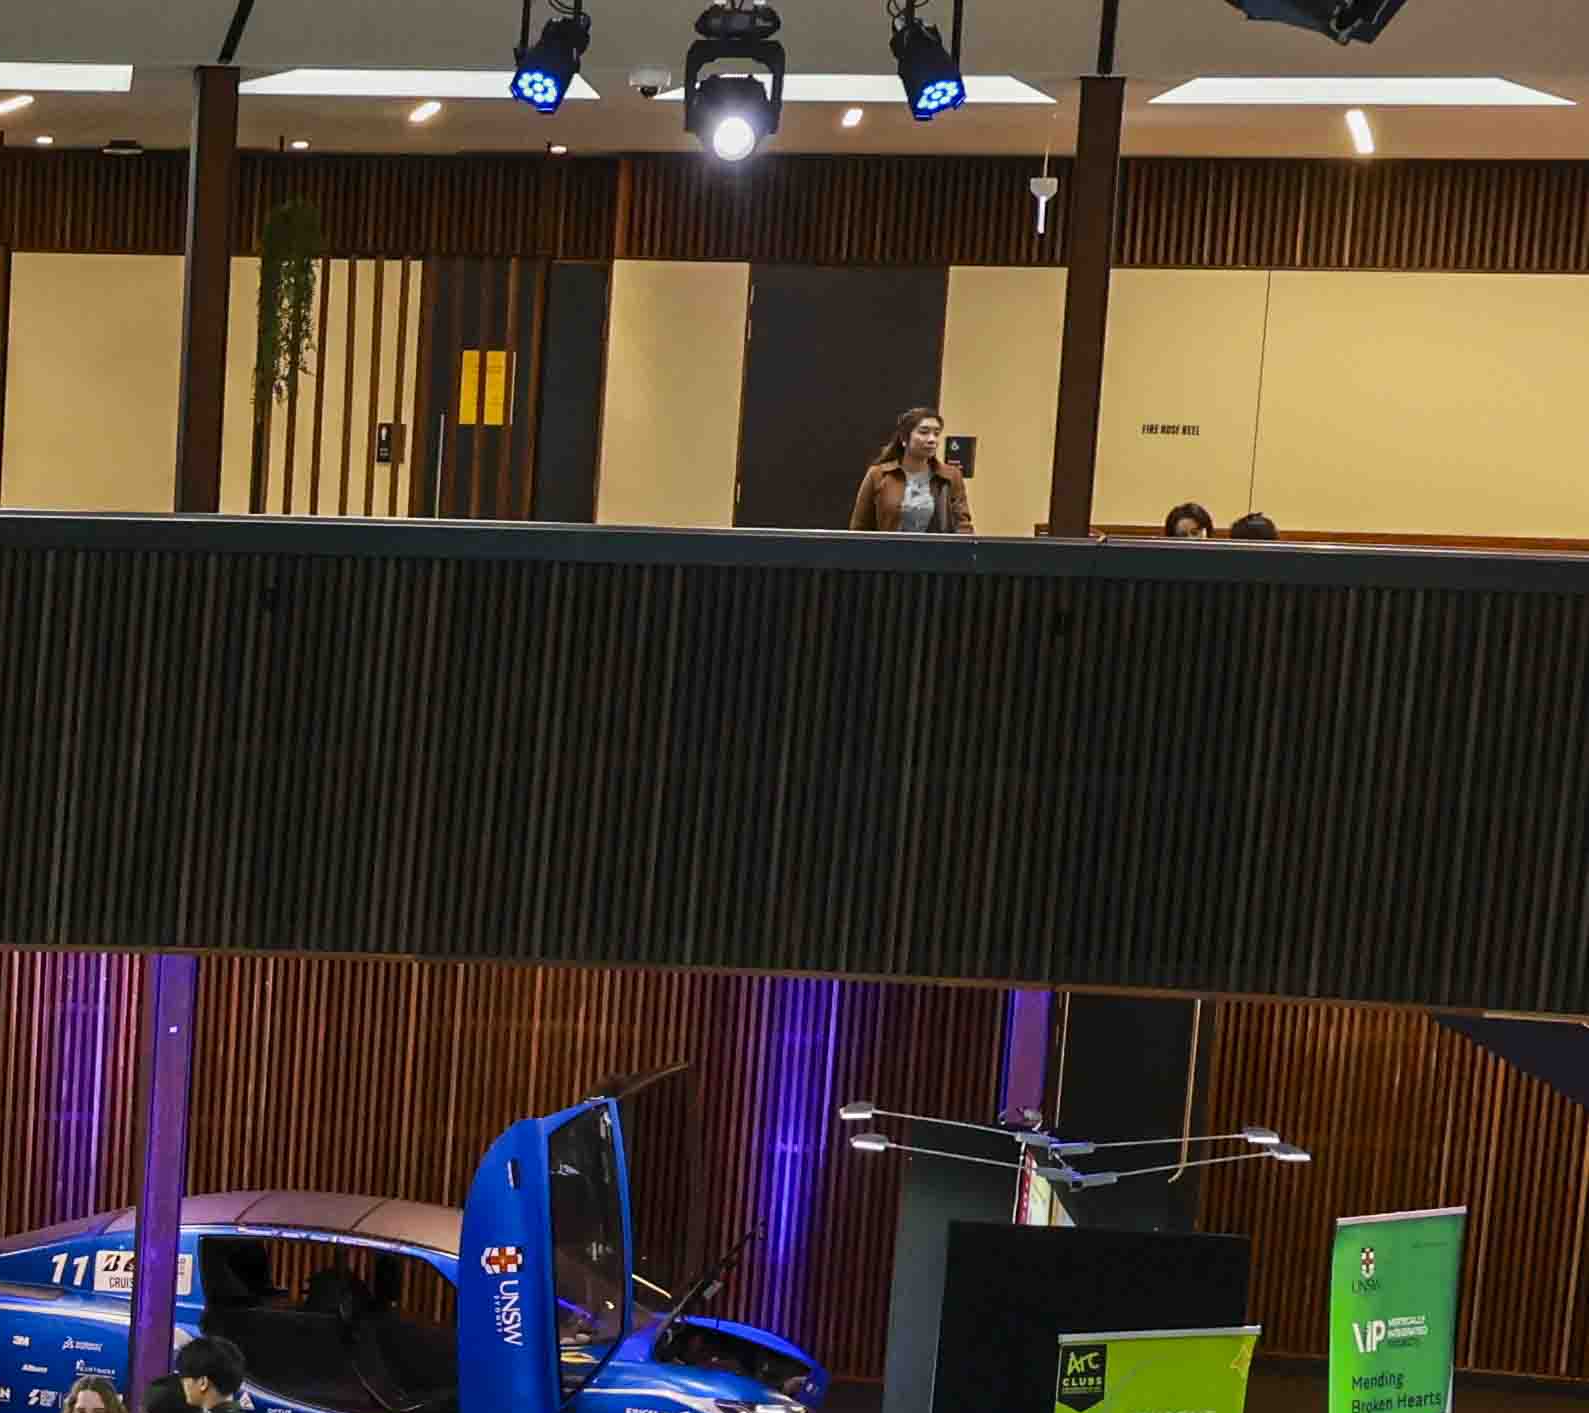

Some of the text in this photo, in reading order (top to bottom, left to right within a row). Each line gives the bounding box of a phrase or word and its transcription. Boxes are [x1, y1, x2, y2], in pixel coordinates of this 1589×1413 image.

[51, 1253, 89, 1287] 11
[499, 1280, 523, 1346] UNSW
[1062, 1376, 1102, 1387] CLUBS
[1352, 1373, 1404, 1392] Mending
[1398, 1391, 1442, 1409] Hearts
